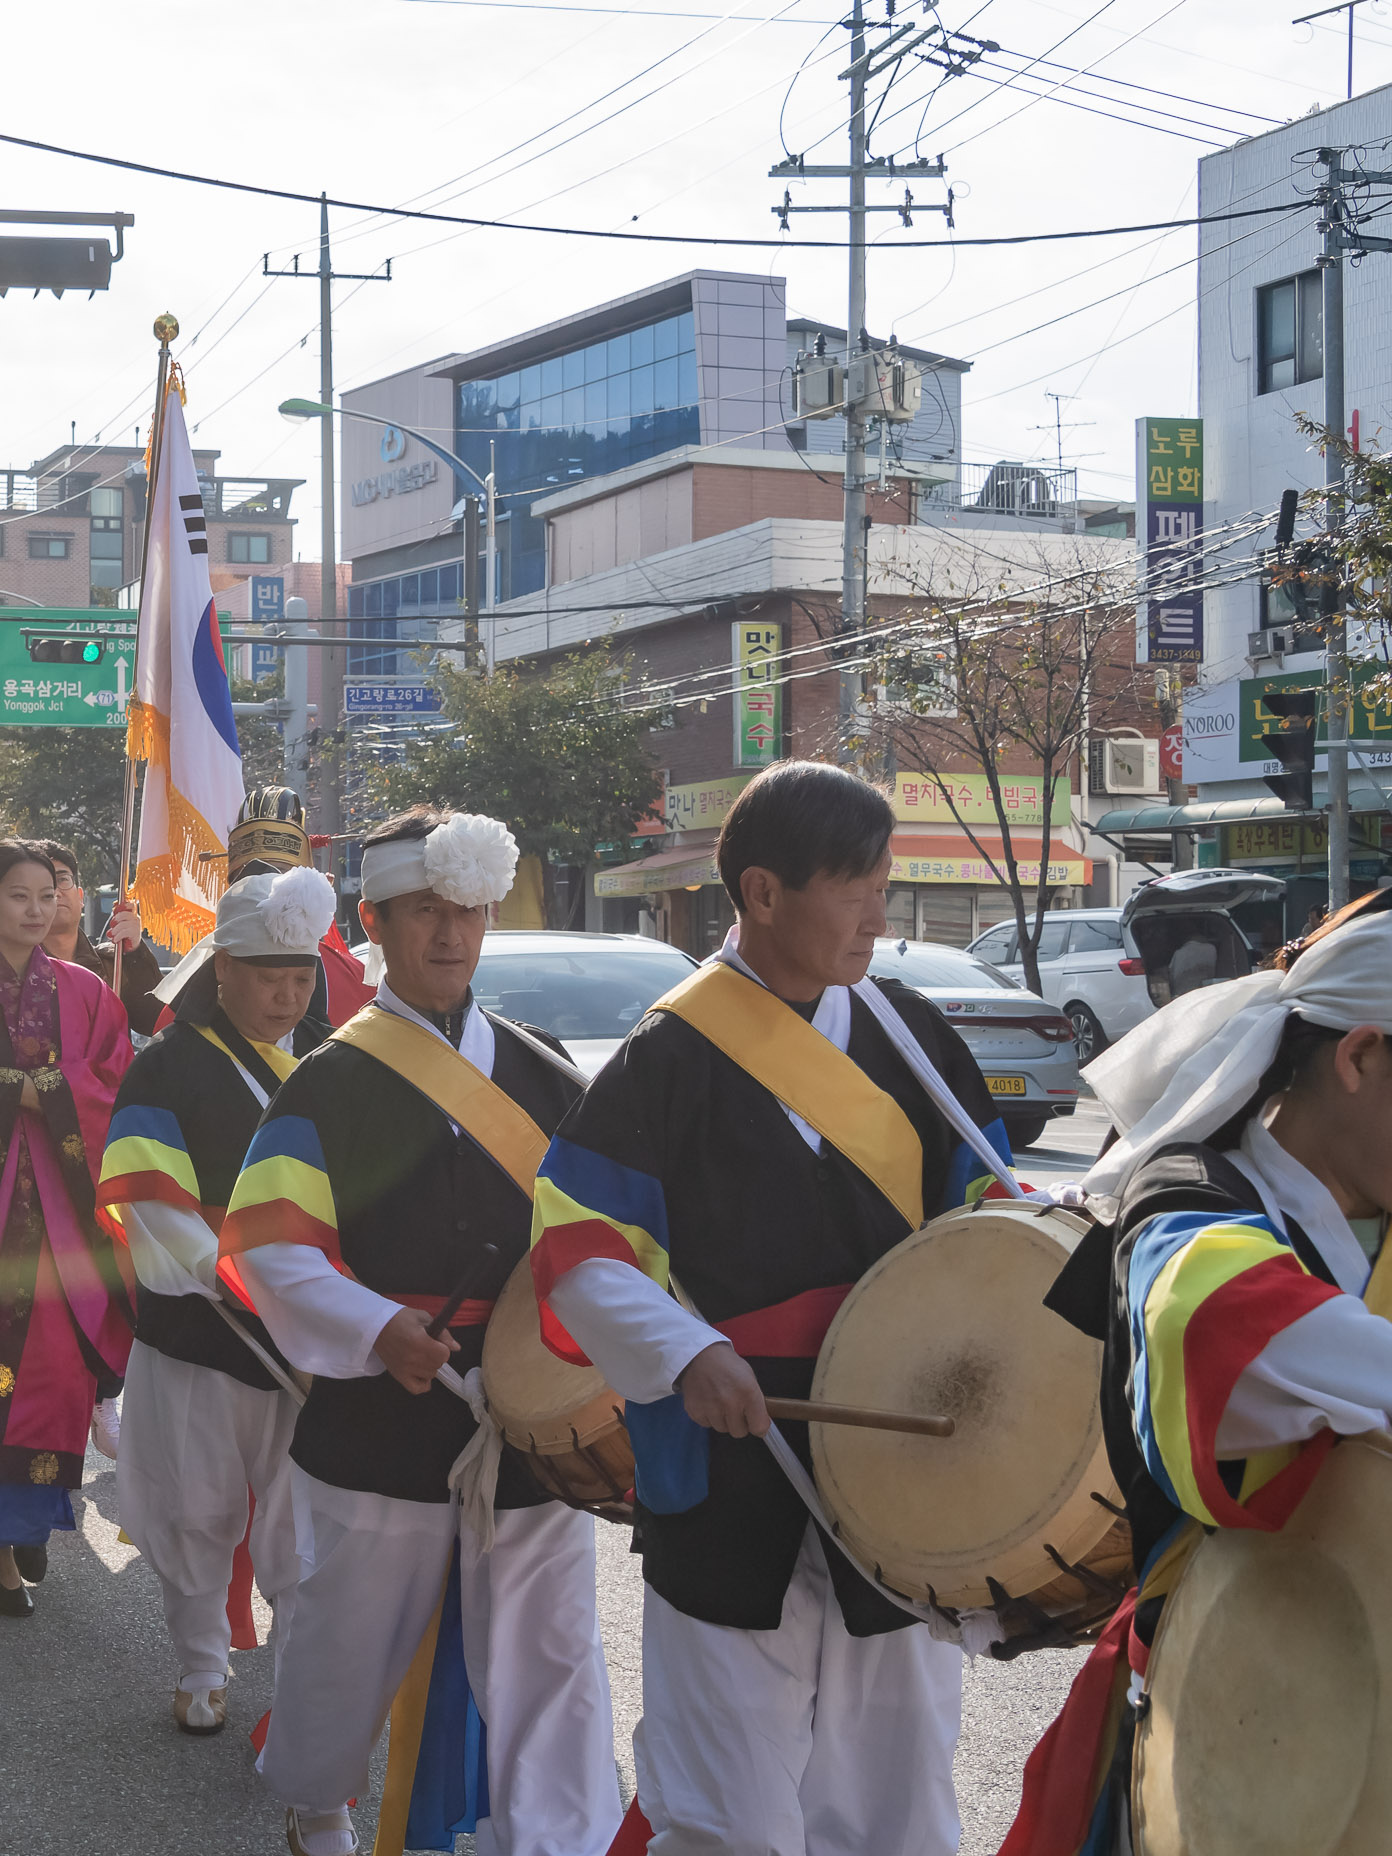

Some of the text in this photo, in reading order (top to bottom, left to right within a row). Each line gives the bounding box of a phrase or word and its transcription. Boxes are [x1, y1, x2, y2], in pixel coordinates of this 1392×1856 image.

[1149, 427, 1200, 459] 노루
[1148, 465, 1201, 497] 삼화
[3, 679, 82, 698] 용곡삼거리
[349, 688, 424, 703] 긴고랑로26길
[100, 693, 112, 703] 71
[3, 700, 64, 714] Yonggok Jct
[1186, 713, 1235, 736] NOROO
[1046, 865, 1069, 881] 김밥
[991, 1079, 1021, 1092] 4018
